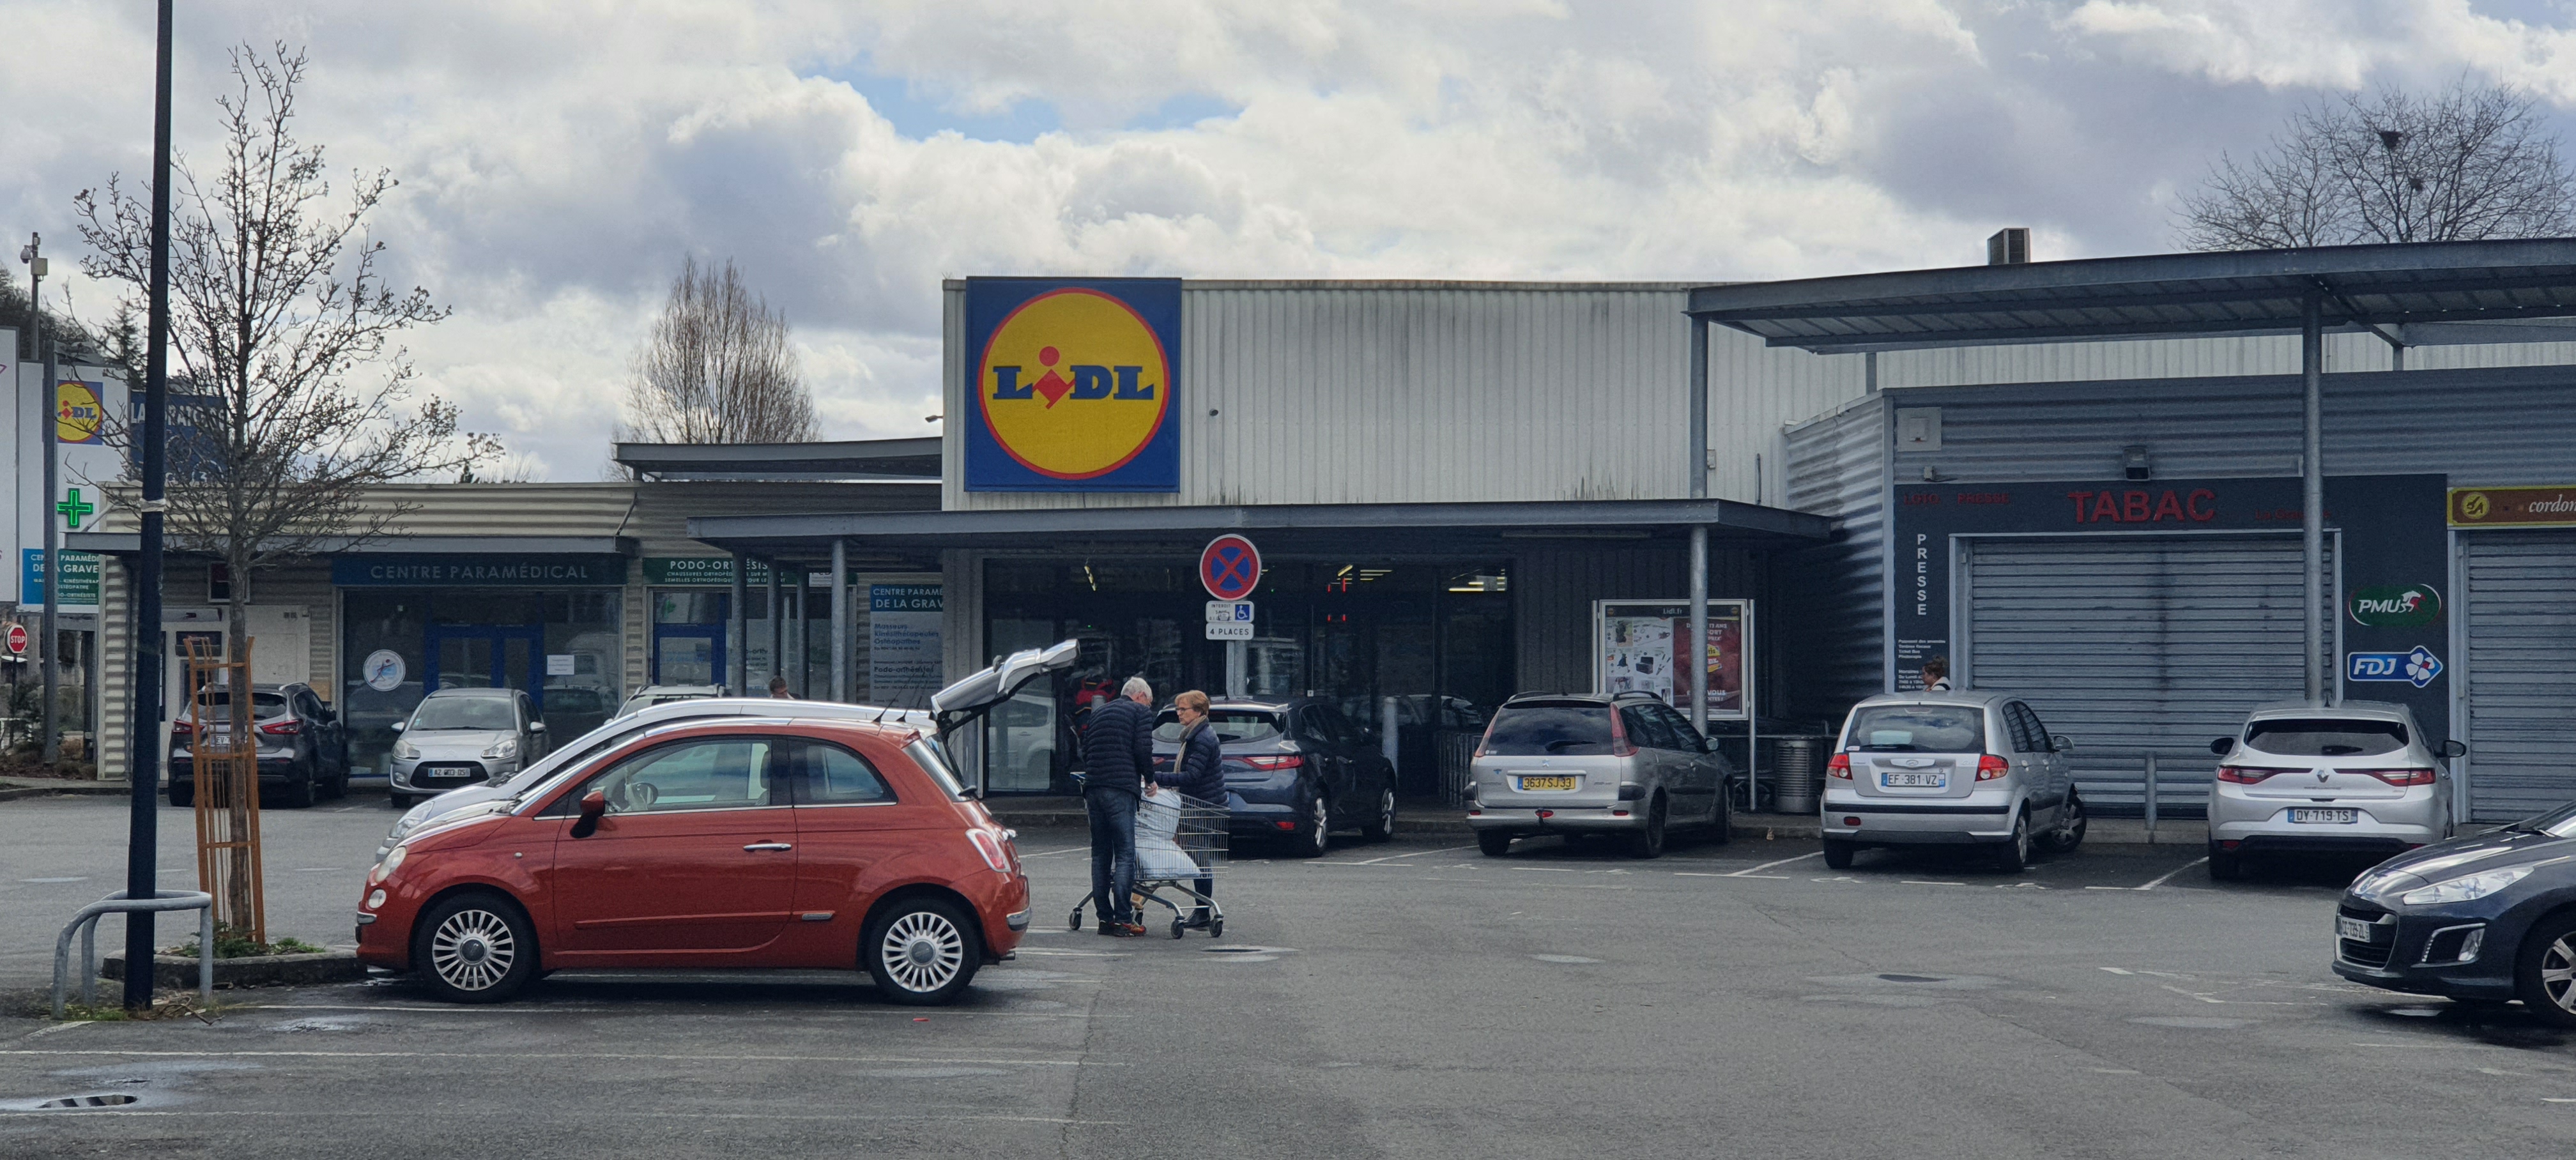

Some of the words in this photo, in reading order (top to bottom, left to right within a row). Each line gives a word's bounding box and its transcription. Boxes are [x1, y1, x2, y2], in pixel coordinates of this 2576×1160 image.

[1904, 493, 1940, 505] LOTO
[1958, 493, 2010, 505] PRESSE
[2067, 489, 2216, 523] TABAC
[61, 554, 99, 562] PARAMÉD
[371, 565, 441, 579] CENTRE
[450, 563, 588, 579] PARAMÉDICAL
[1917, 534, 1928, 615] PRESSE
[876, 599, 890, 608] DE
[894, 599, 907, 608] LA
[2359, 599, 2401, 613] PMU
[10, 636, 26, 644] STOP
[2354, 658, 2396, 675] FDJ
